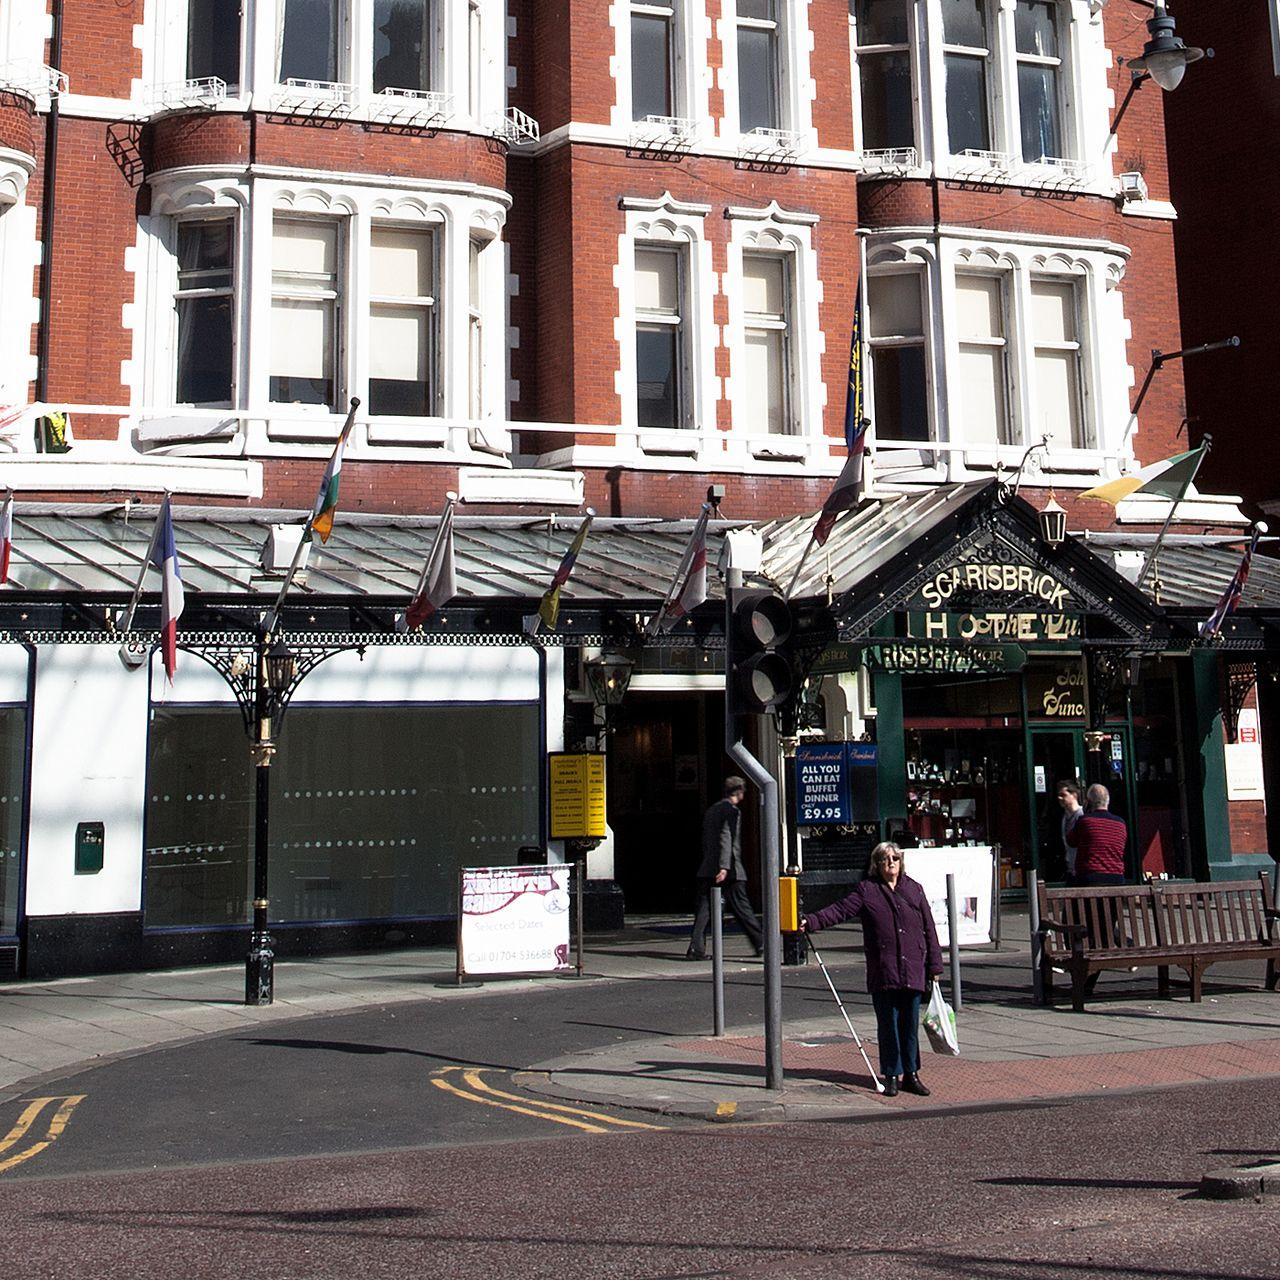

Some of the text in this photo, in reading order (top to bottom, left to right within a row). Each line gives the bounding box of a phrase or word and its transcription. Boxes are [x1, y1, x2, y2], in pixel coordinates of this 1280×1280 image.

[922, 564, 1069, 608] SCARISBRICK
[926, 613, 1068, 639] HOTEL
[802, 765, 840, 774] ALL YOU
[802, 775, 840, 783] CAN EAT
[806, 784, 837, 793] BUFFET
[804, 794, 839, 803] DINNER
[804, 807, 842, 819] £9.95
[474, 919, 544, 932] Selected Dates
[489, 950, 517, 962] 01704
